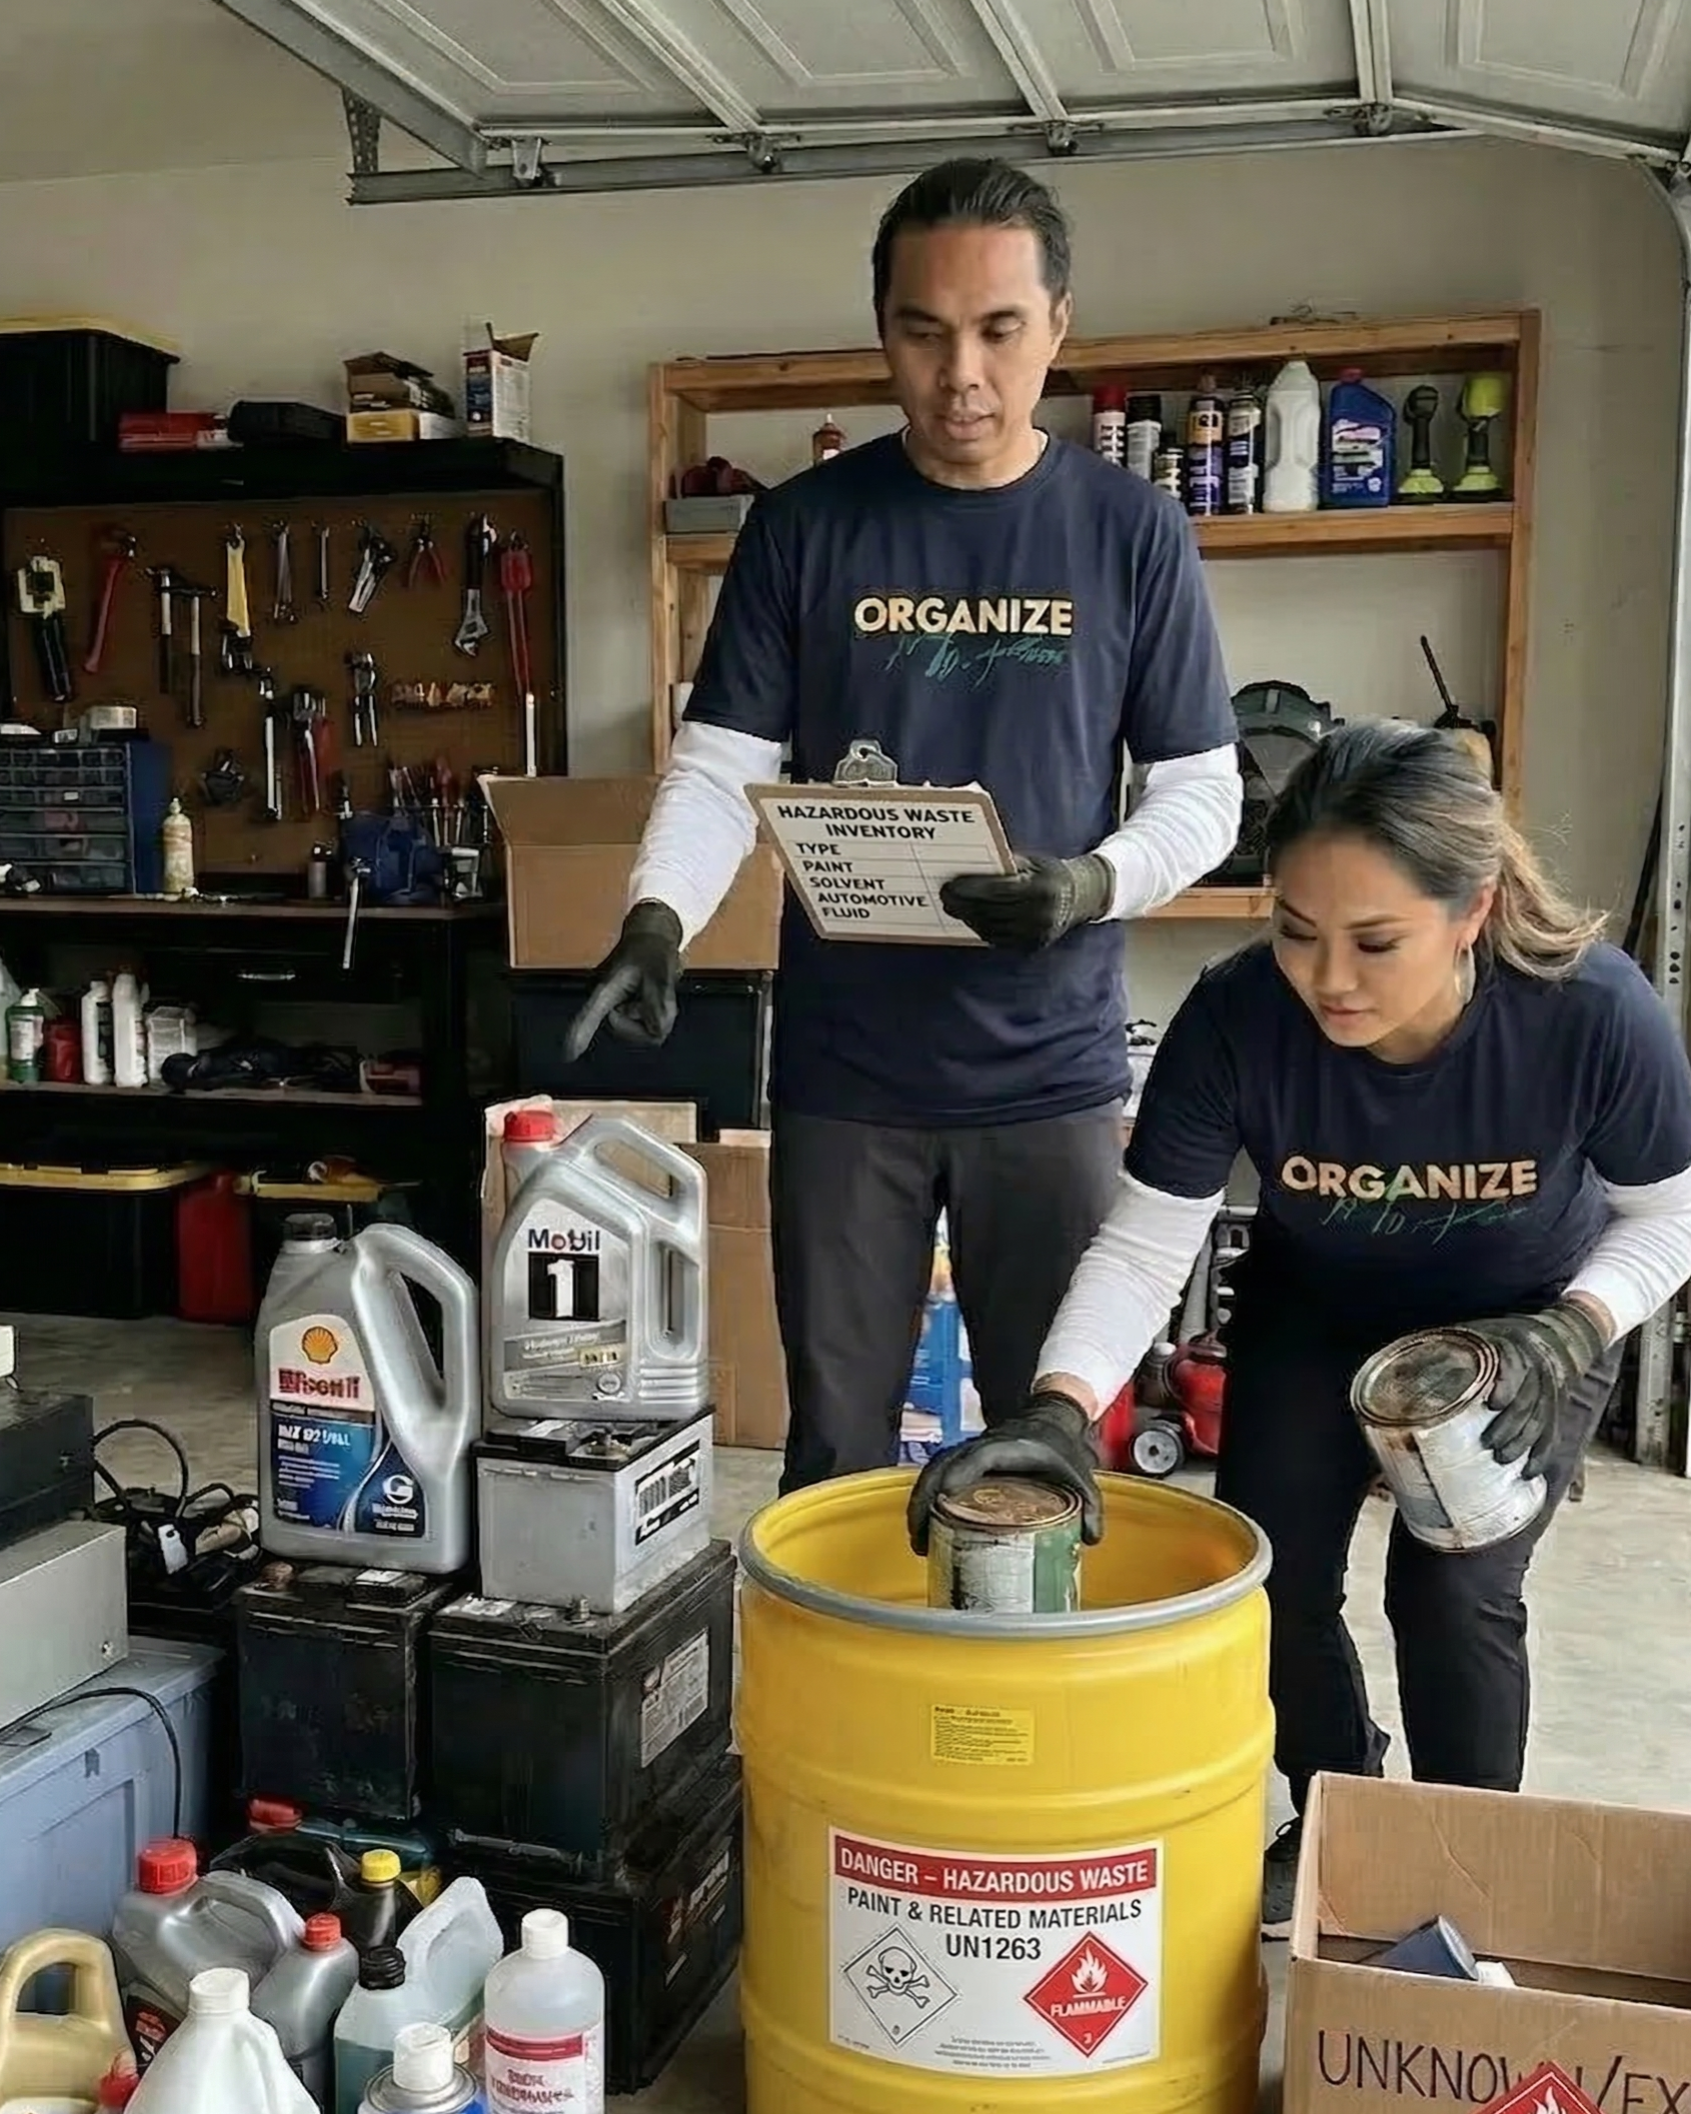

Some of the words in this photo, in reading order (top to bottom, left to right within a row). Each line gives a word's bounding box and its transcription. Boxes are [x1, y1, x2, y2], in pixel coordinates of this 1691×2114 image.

[854, 597, 1073, 636] ORGANIZE
[777, 805, 899, 821] HAZARDOUS
[904, 808, 975, 823] WASTE
[825, 823, 936, 840] INVENTORY
[796, 843, 841, 856] TYPE
[802, 860, 853, 873] PAINT
[809, 877, 885, 890] SOLVENT
[817, 893, 929, 908] AUTOMOTIVE
[822, 907, 870, 919] FLUID
[1281, 1154, 1538, 1202] ORGANIZE
[840, 1847, 919, 1885] DANGER
[943, 1867, 1075, 1894] HAZARDOUS
[1079, 1860, 1148, 1891] WASTE
[847, 1887, 902, 1917] PAINT
[908, 1901, 923, 1921] &
[929, 1904, 1021, 1929] RELATED
[1029, 1899, 1142, 1929] MATERIALS
[946, 1933, 1042, 1960] UN1263
